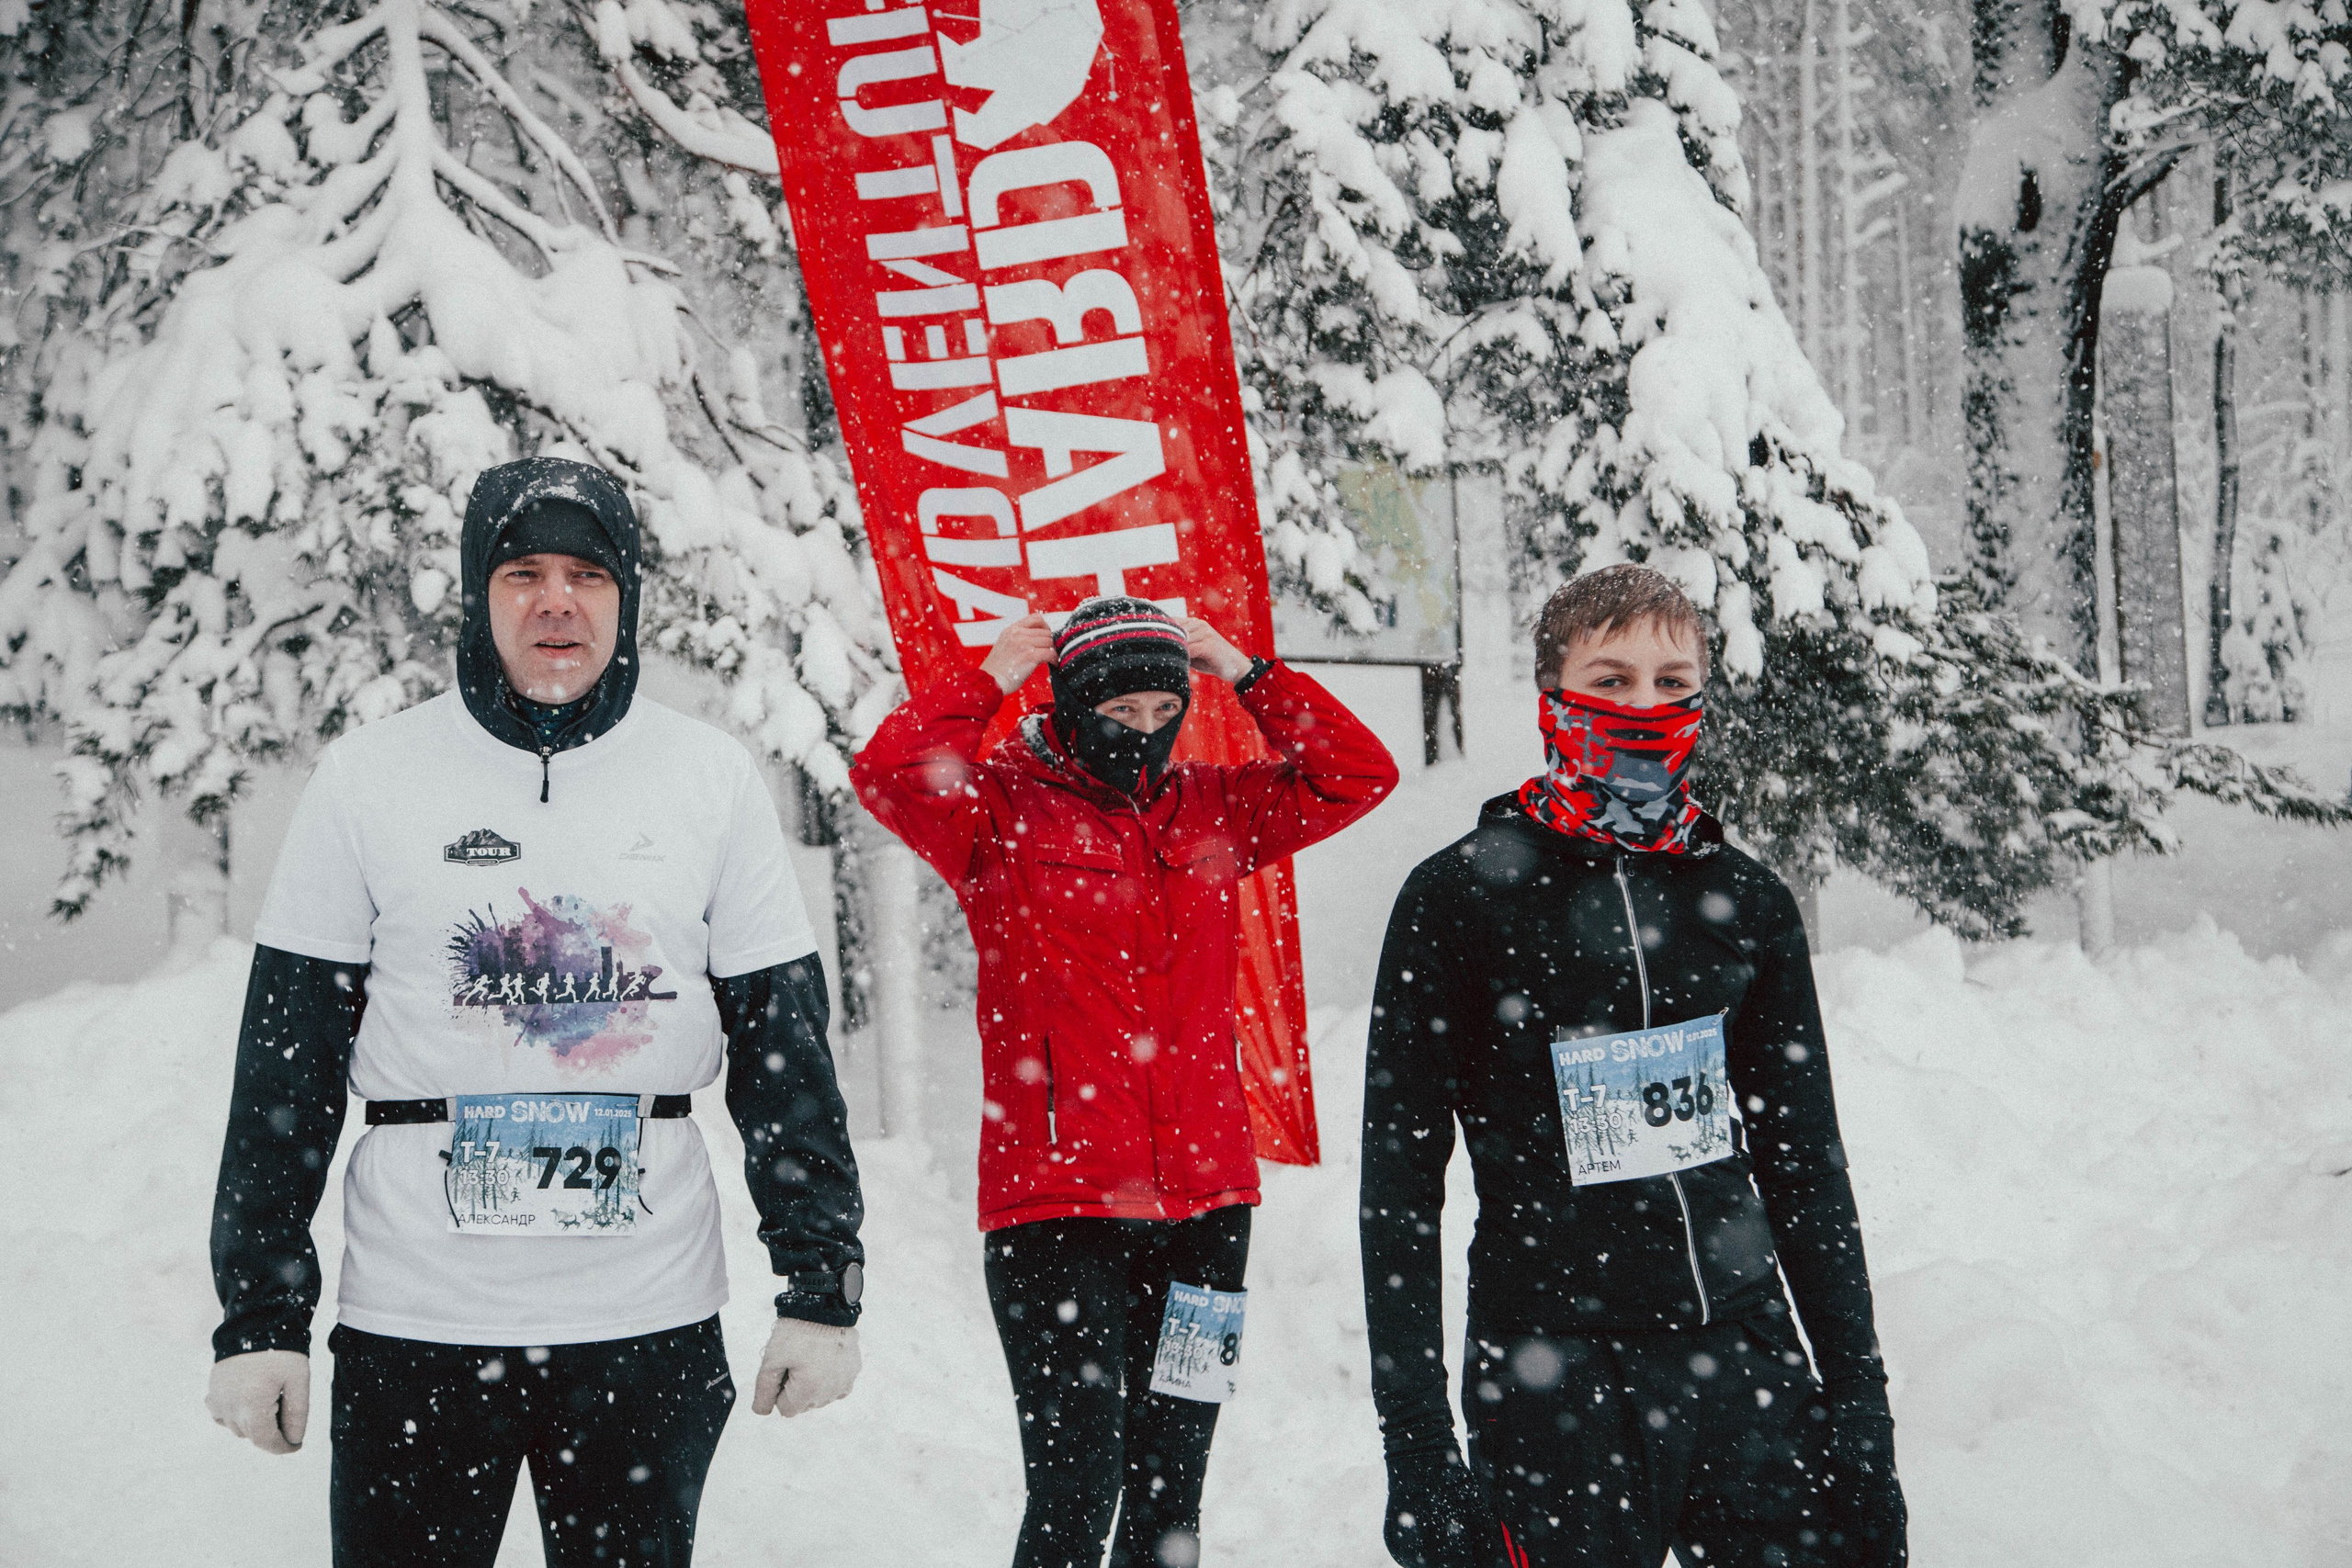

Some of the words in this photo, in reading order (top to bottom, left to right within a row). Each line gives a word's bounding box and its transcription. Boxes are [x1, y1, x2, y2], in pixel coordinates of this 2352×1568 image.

[466, 846, 512, 857] TOUR
[1558, 1047, 1606, 1066] HARD
[1610, 1029, 1684, 1063] SNOW
[1642, 1071, 1714, 1128] 836
[464, 1104, 506, 1119] HARD
[511, 1100, 592, 1123] SNOW
[594, 1108, 632, 1118] 12.01.2025
[1568, 1112, 1623, 1135] 13:30
[459, 1169, 510, 1185] 13:30
[532, 1146, 623, 1190] 729
[458, 1213, 536, 1226] АЛЕКСАНДР
[1173, 1290, 1210, 1307] HARD
